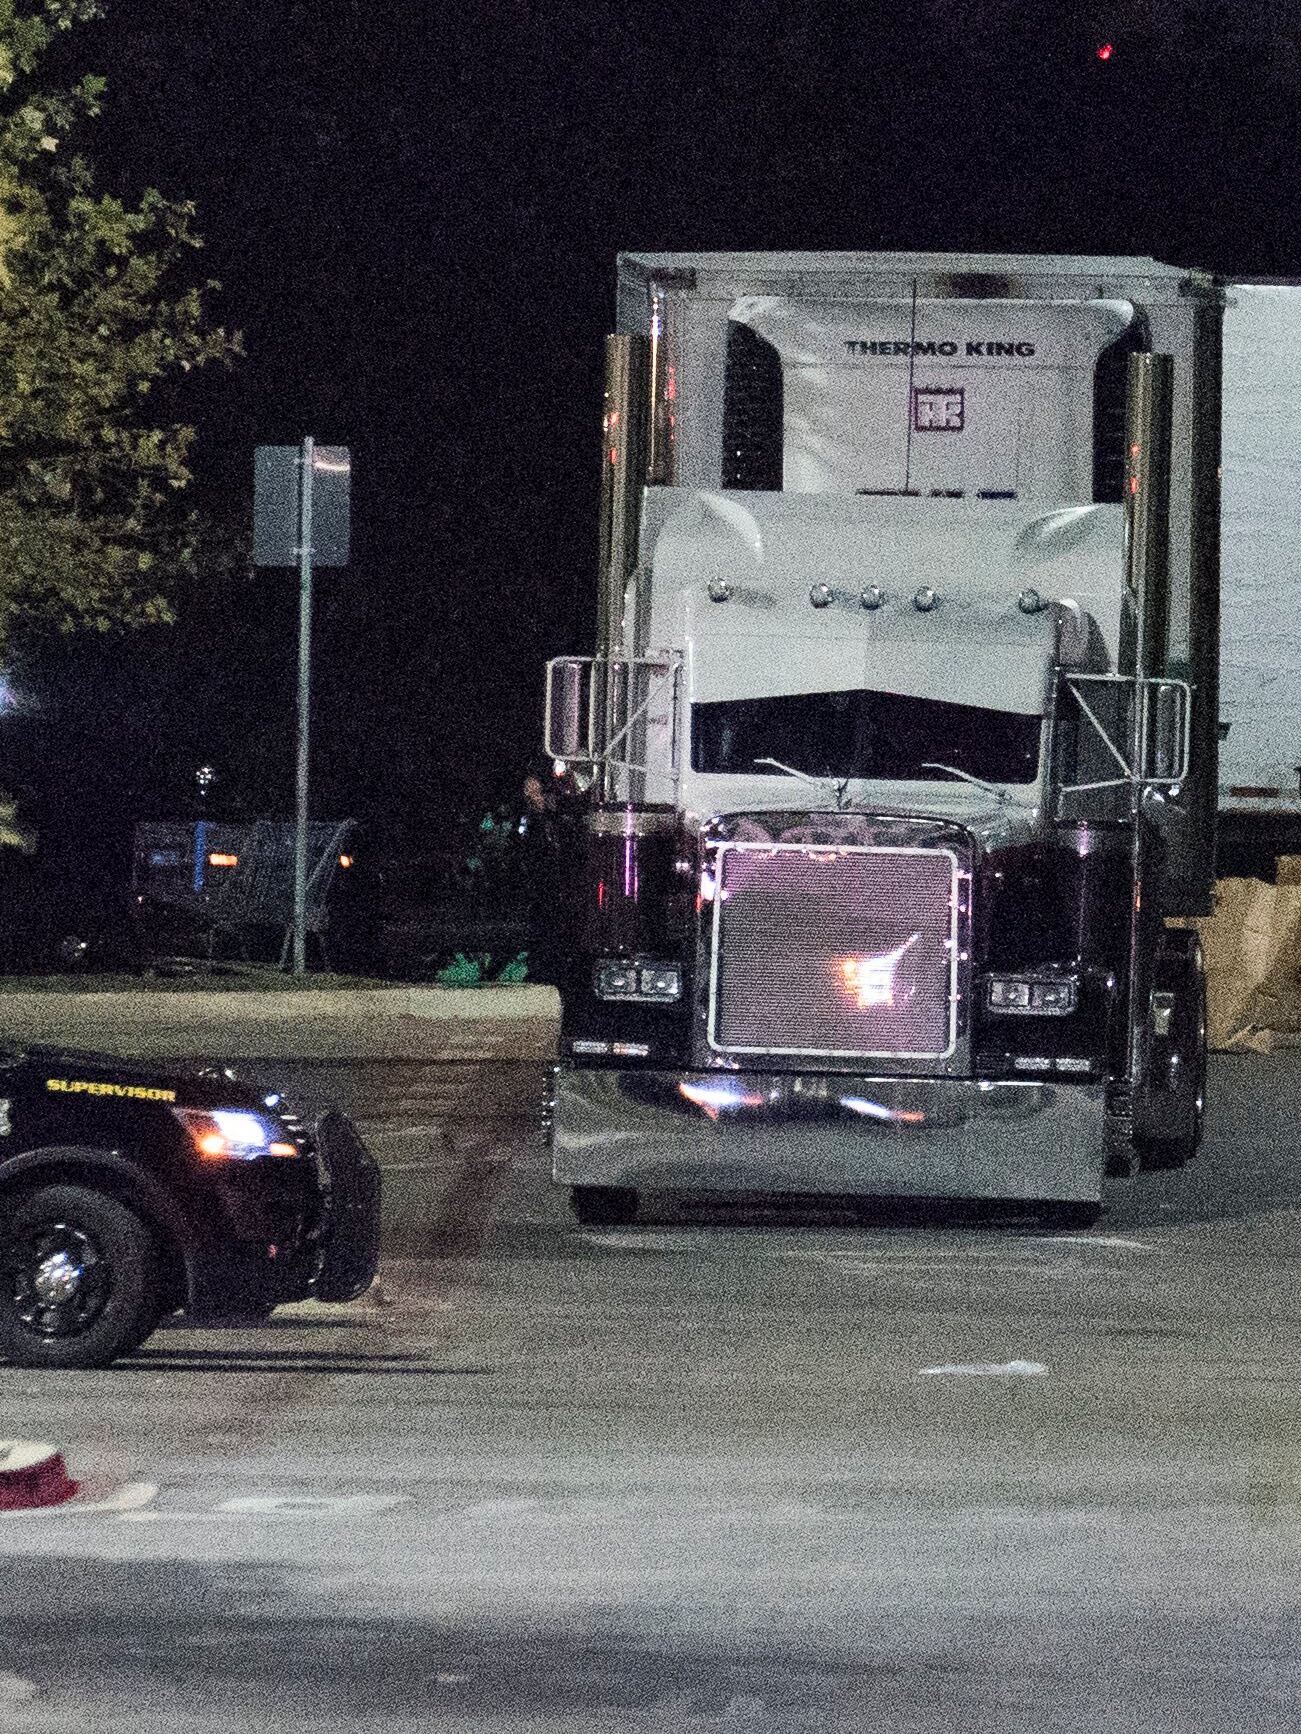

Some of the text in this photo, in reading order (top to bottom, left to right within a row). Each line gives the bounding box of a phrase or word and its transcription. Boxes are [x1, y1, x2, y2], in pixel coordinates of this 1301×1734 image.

[845, 340, 1036, 357] THERMO KING
[47, 1079, 176, 1101] SUPERVISOR
